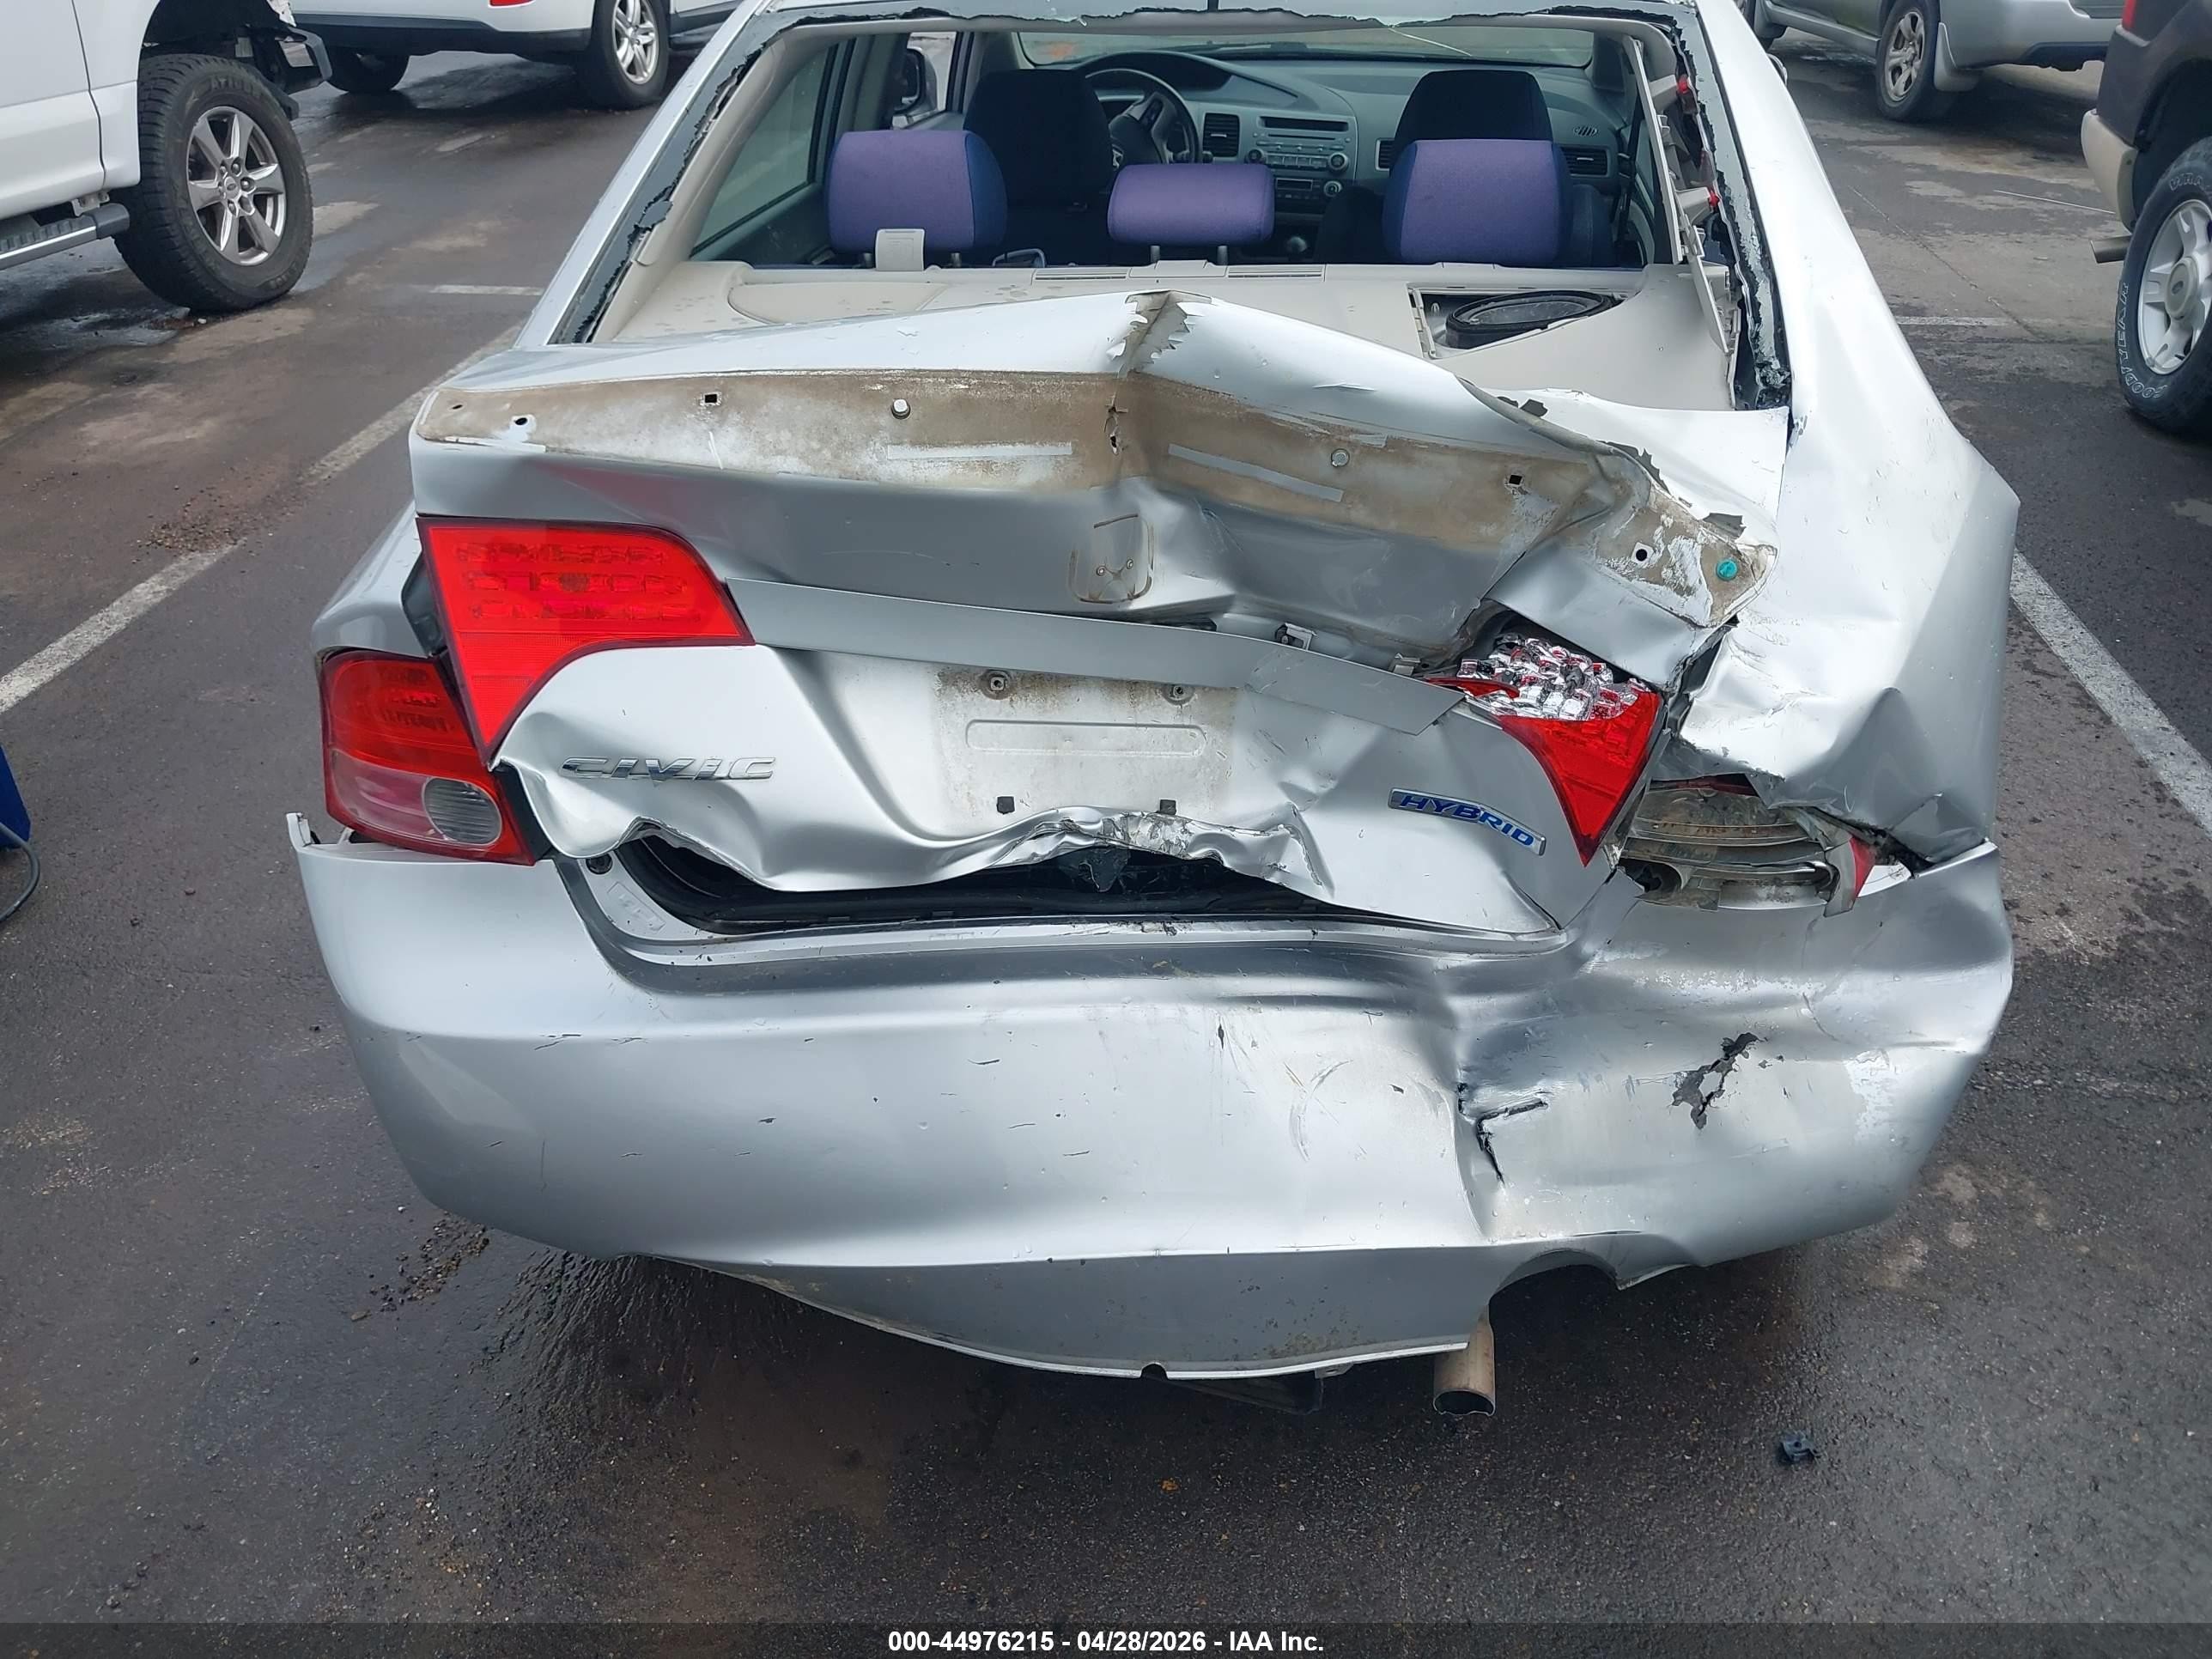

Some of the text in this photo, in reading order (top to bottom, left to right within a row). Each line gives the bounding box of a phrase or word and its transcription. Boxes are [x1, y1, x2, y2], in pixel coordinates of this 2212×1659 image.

[2118, 282, 2168, 398] GOODYEAR
[561, 757, 776, 781] CIVIC
[1400, 795, 1534, 847] HYBRID
